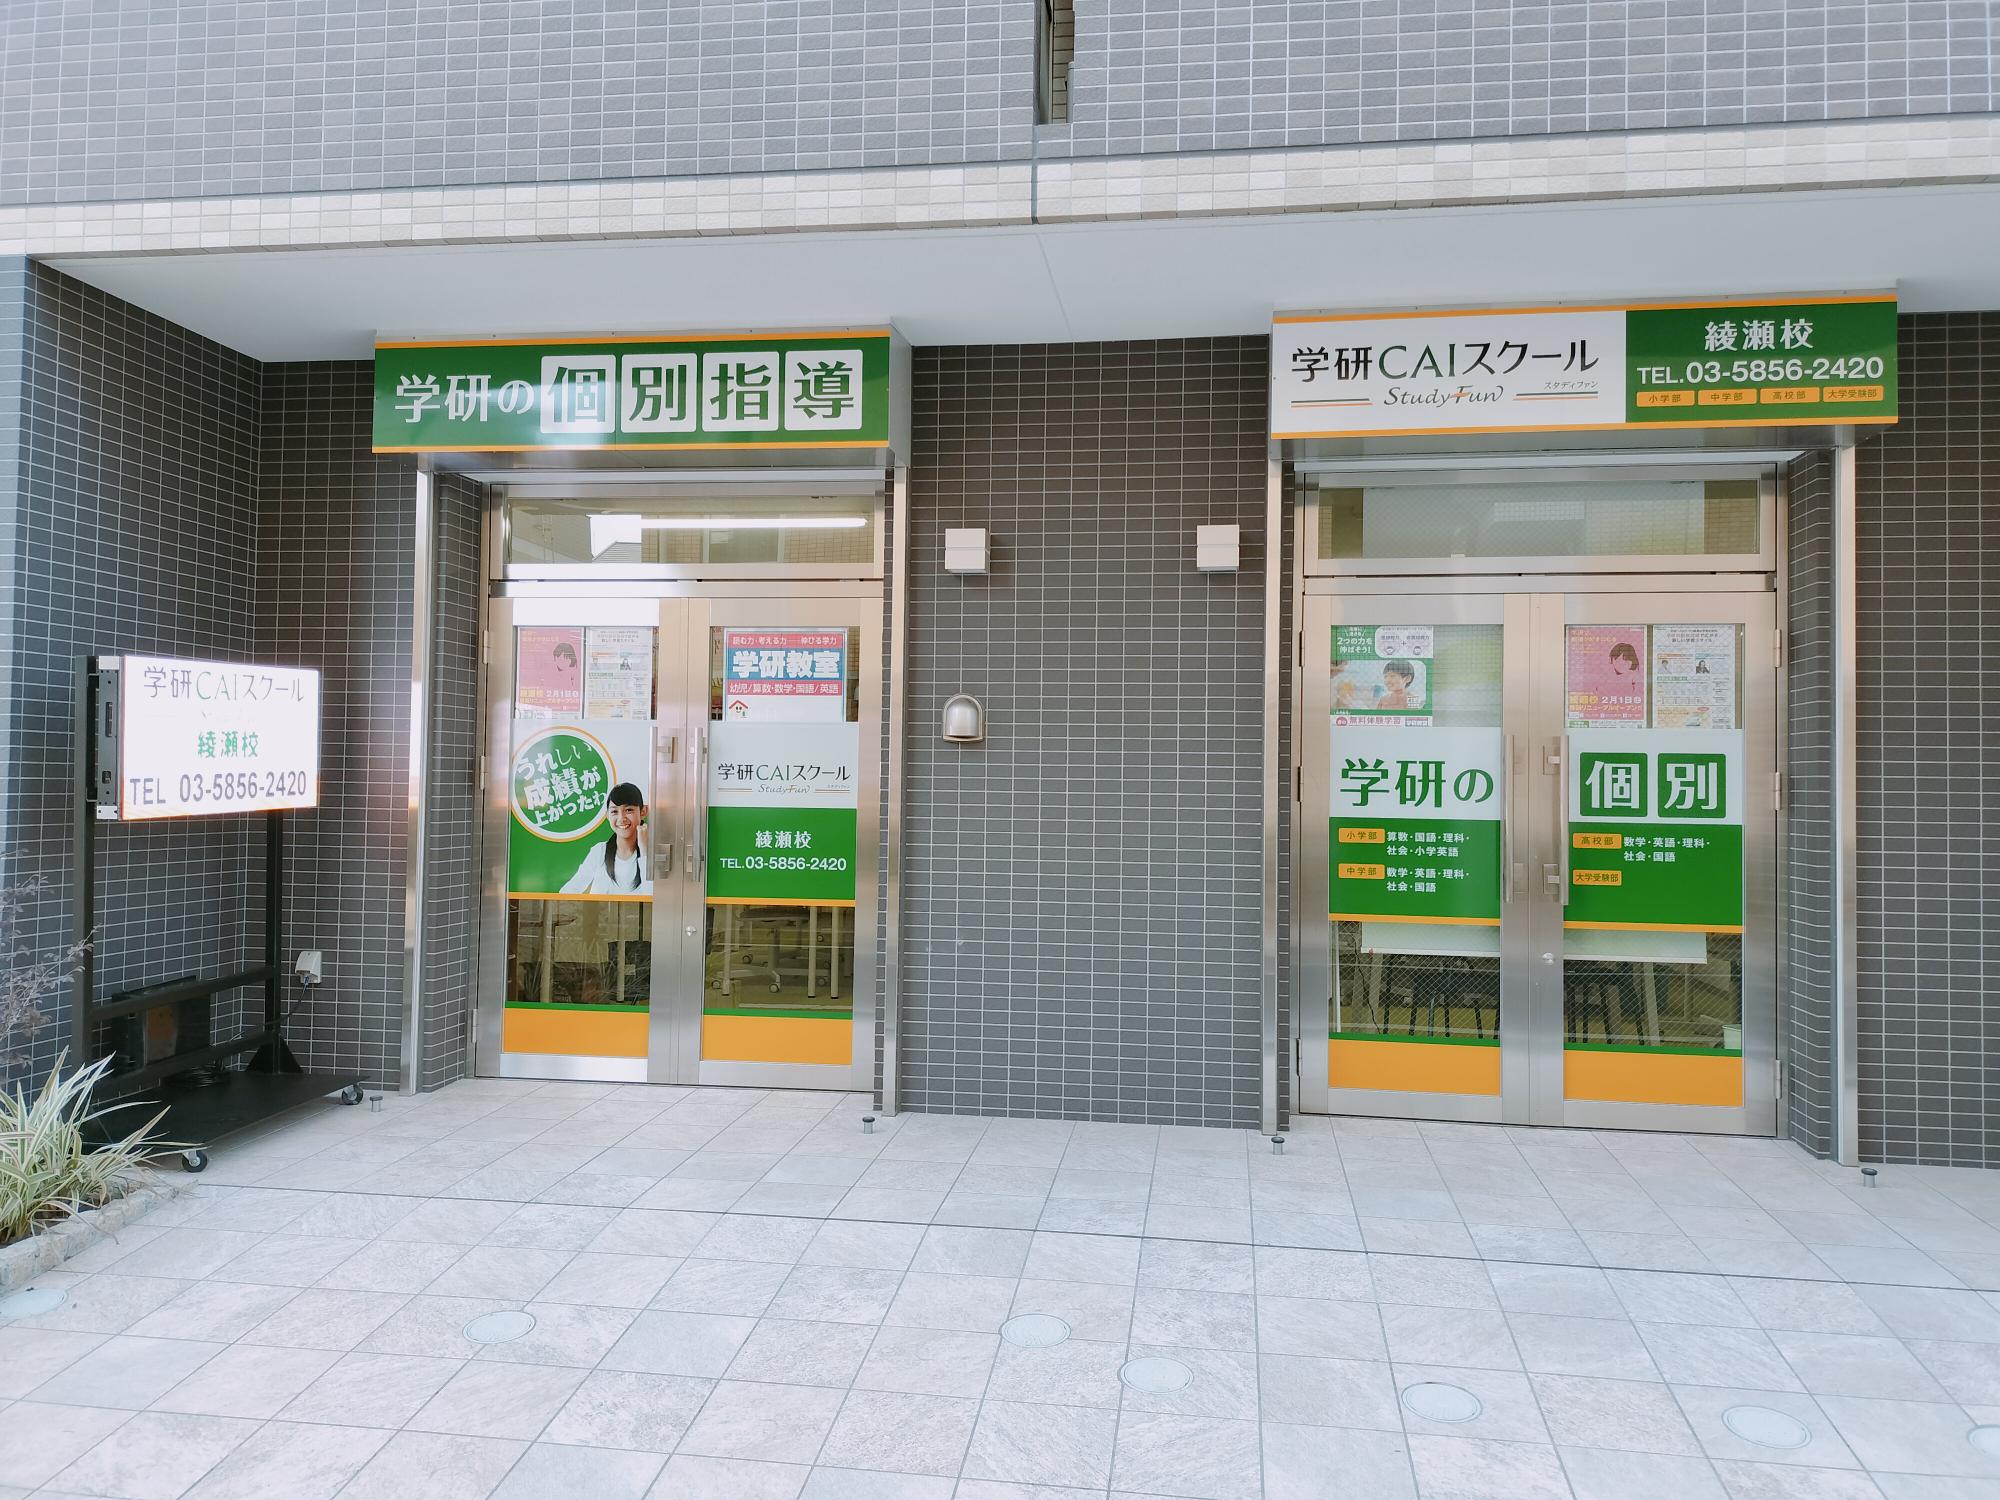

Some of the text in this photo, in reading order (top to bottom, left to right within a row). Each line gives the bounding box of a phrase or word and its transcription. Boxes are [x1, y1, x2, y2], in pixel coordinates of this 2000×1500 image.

[1704, 319, 1814, 352] 綾瀬校
[1291, 340, 1599, 382] 学研CAIスクール
[395, 361, 854, 424] 学研の個別指導
[1544, 380, 1599, 390] スタディファン
[1648, 388, 1877, 404] 小学部 中学部 高校部 大学受験部
[732, 650, 840, 679] 学研教室
[144, 665, 305, 702] 学研CAIスクール
[198, 731, 259, 758] 綾瀬校
[517, 742, 592, 780] うれしい
[718, 763, 851, 781] 学研CAIスクール
[130, 770, 307, 805] TEL 03-5856-2420
[524, 766, 601, 810] 成績が
[1340, 758, 1494, 808] 学研の
[1585, 761, 1718, 810] 個別
[755, 830, 812, 848] 綾瀬校
[1347, 832, 1377, 840] 小学部
[1581, 836, 1614, 845] 高校部
[1387, 846, 1459, 857] 社会・小学英語
[1624, 851, 1676, 862] 社会・国語
[1347, 867, 1377, 876] 中学部
[1576, 873, 1619, 882] 大学受験部
[1387, 881, 1436, 892] 社会・国語
